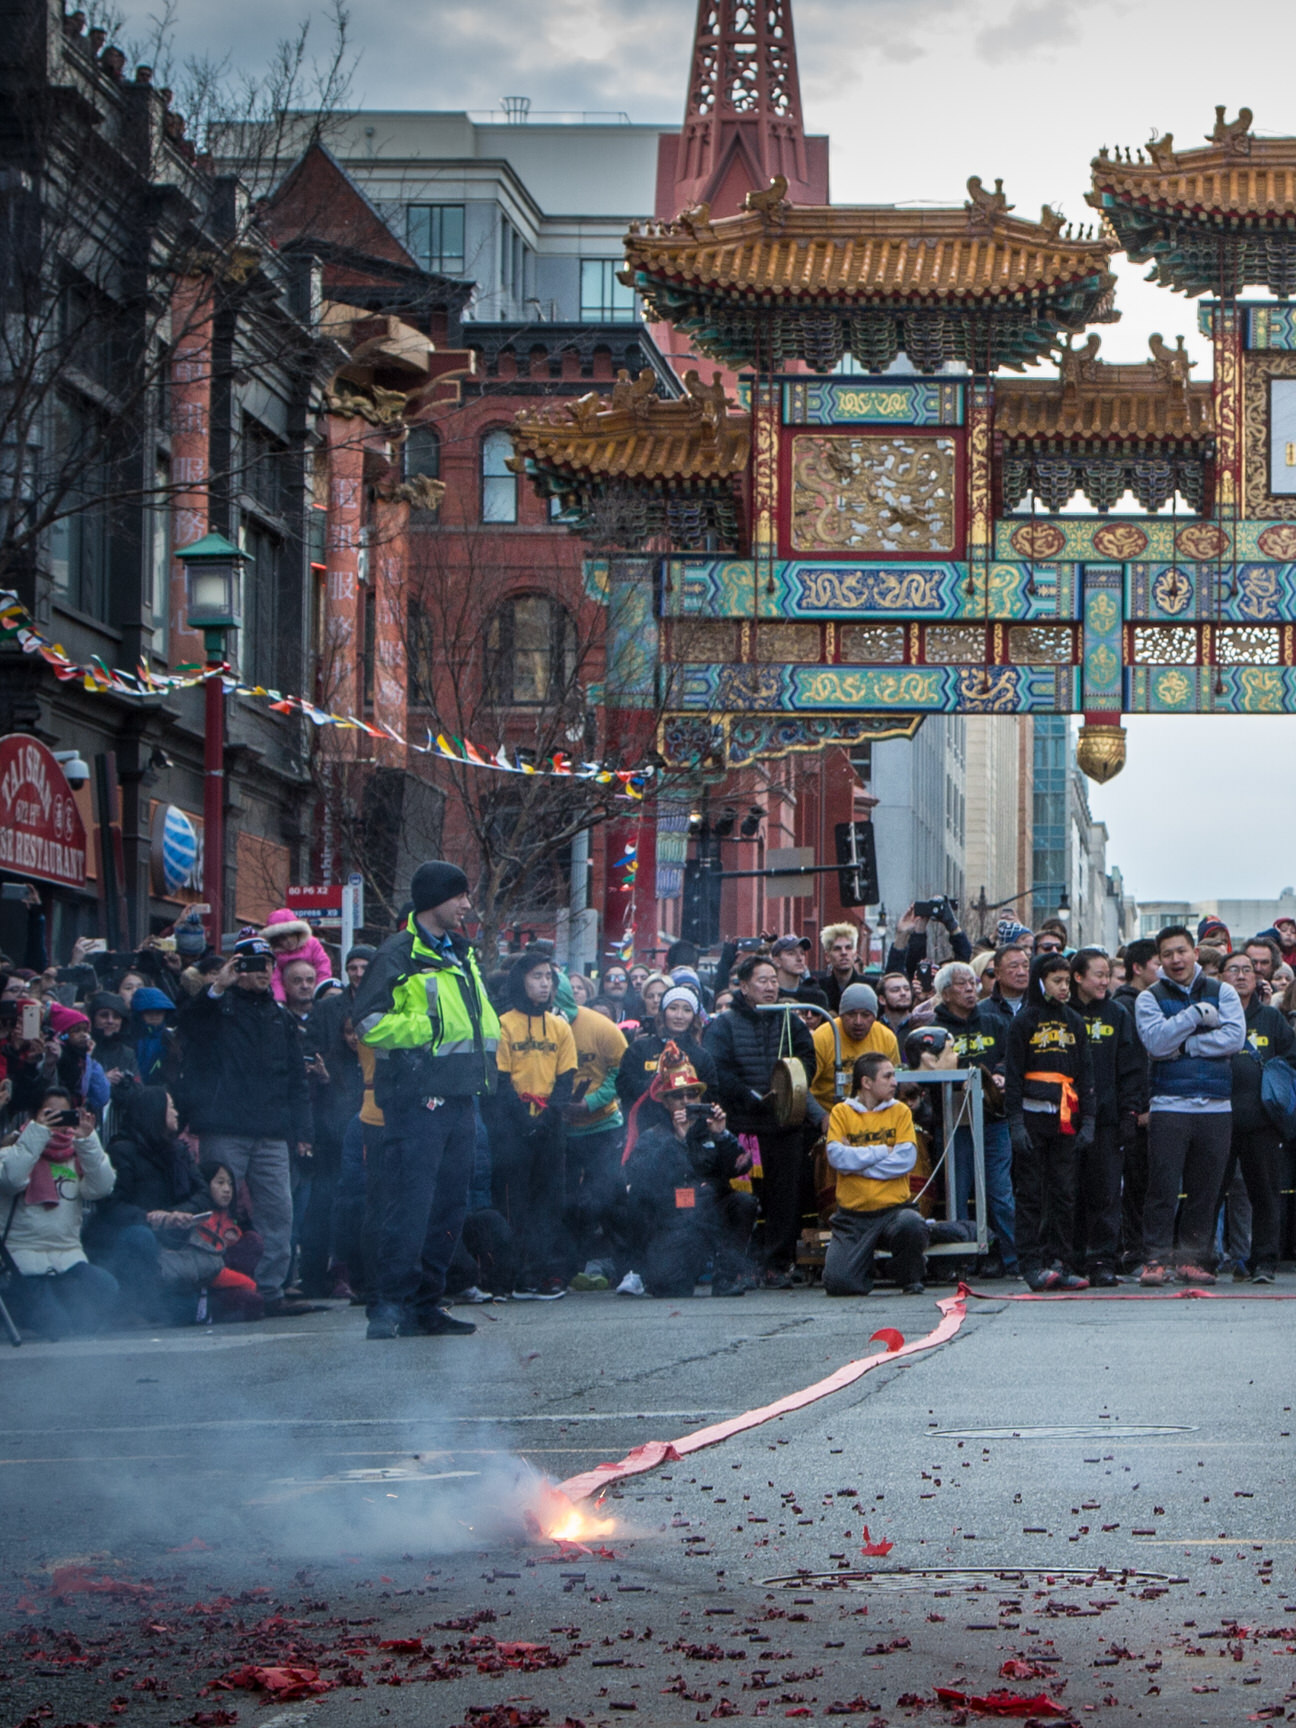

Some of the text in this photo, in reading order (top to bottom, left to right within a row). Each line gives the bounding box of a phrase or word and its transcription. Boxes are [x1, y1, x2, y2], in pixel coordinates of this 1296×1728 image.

[1, 747, 24, 813] TAI
[26, 744, 53, 822] SHAN
[15, 831, 85, 882] RESTAURANT
[320, 805, 333, 886] ashington
[295, 909, 321, 917] xpress
[317, 887, 328, 895] X2
